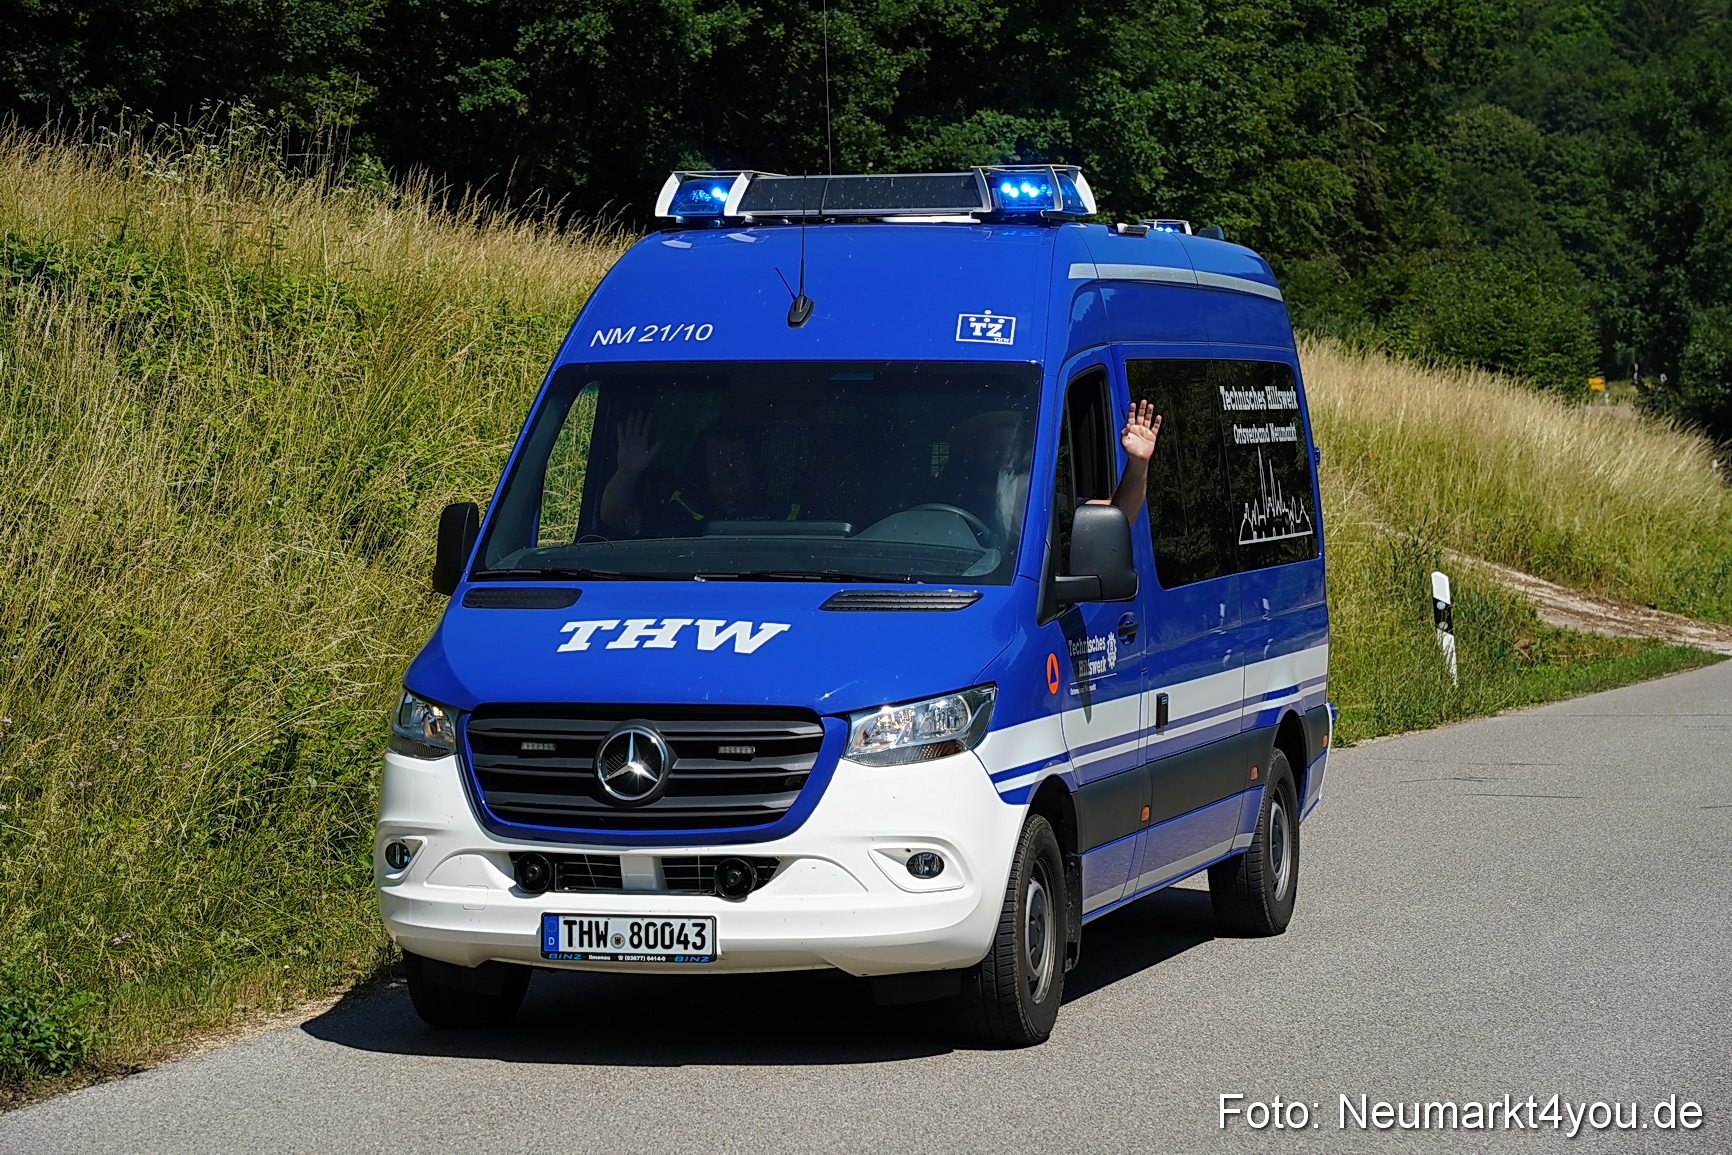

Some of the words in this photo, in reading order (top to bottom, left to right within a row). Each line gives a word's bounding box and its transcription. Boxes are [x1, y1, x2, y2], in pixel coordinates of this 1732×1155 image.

[589, 326, 637, 347] NM
[637, 323, 714, 342] 21/10
[970, 322, 1003, 338] TZ
[1219, 385, 1267, 411] Technisches
[1264, 385, 1299, 410] Hilfswerk
[556, 618, 792, 654] THW
[1068, 634, 1106, 656] Technisches
[548, 937, 555, 946] D
[562, 919, 609, 948] THW
[629, 921, 707, 951] 80043
[548, 952, 582, 960] BINZ
[674, 955, 710, 963] BINZ
